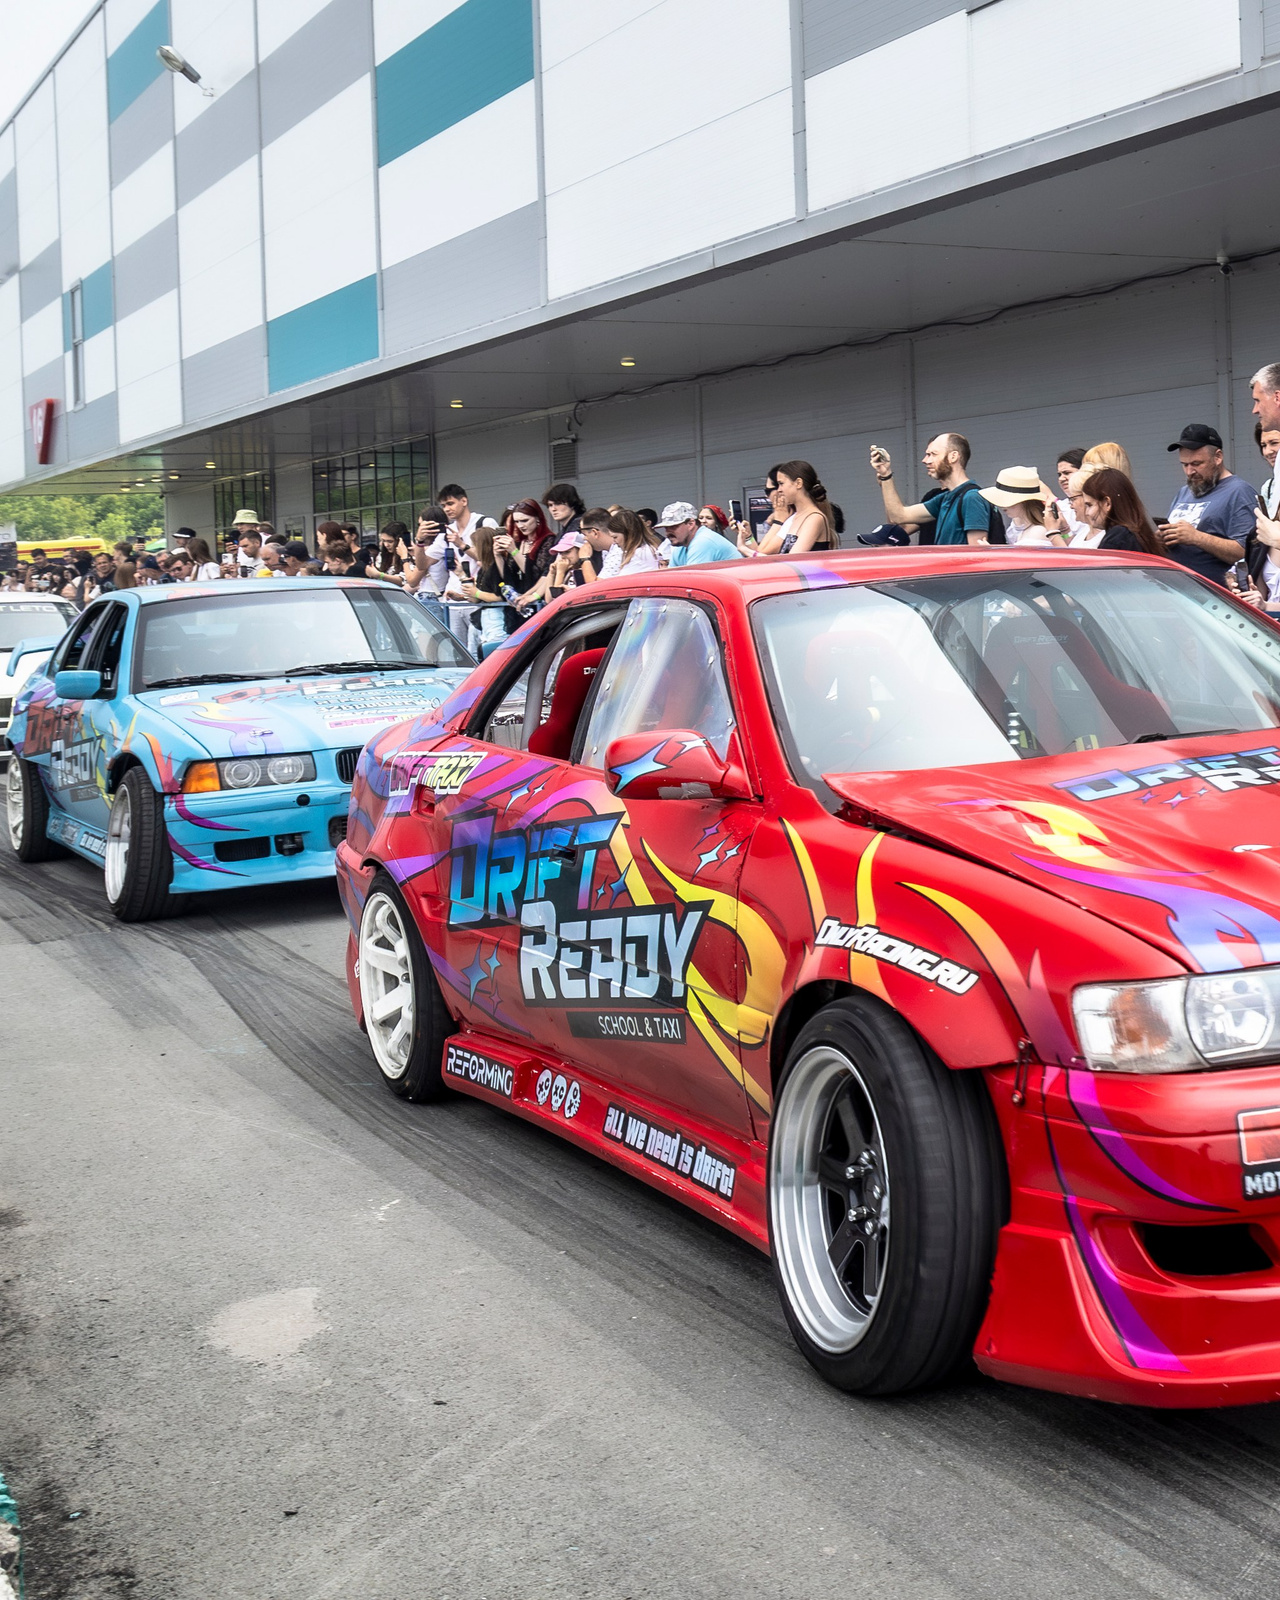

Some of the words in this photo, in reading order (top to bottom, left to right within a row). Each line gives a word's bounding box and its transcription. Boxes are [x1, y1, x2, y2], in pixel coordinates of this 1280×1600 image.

[450, 815, 618, 925] DRIFT
[520, 900, 704, 1000] READY
[598, 1015, 642, 1036] SCHOOL
[643, 1017, 653, 1037] &
[653, 1017, 682, 1039] TAXI
[677, 1143, 695, 1175] is
